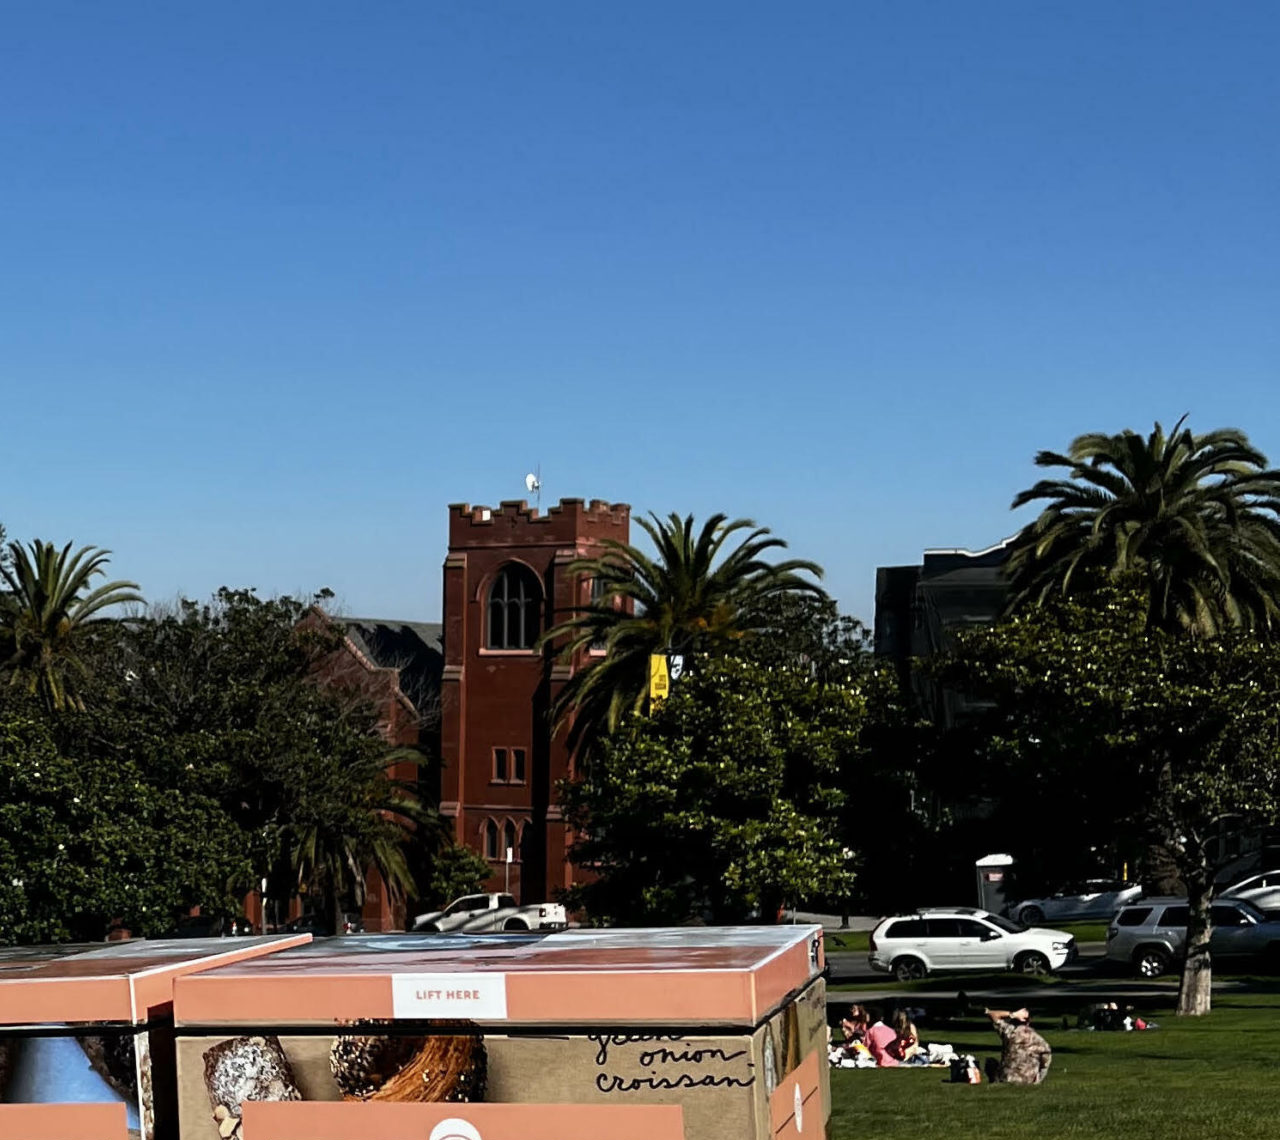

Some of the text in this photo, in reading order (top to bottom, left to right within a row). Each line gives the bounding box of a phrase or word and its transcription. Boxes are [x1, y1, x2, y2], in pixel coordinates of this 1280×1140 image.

[416, 990, 480, 1000] LIFT HERE
[640, 1043, 747, 1066] onion
[596, 1061, 755, 1092] croissan
